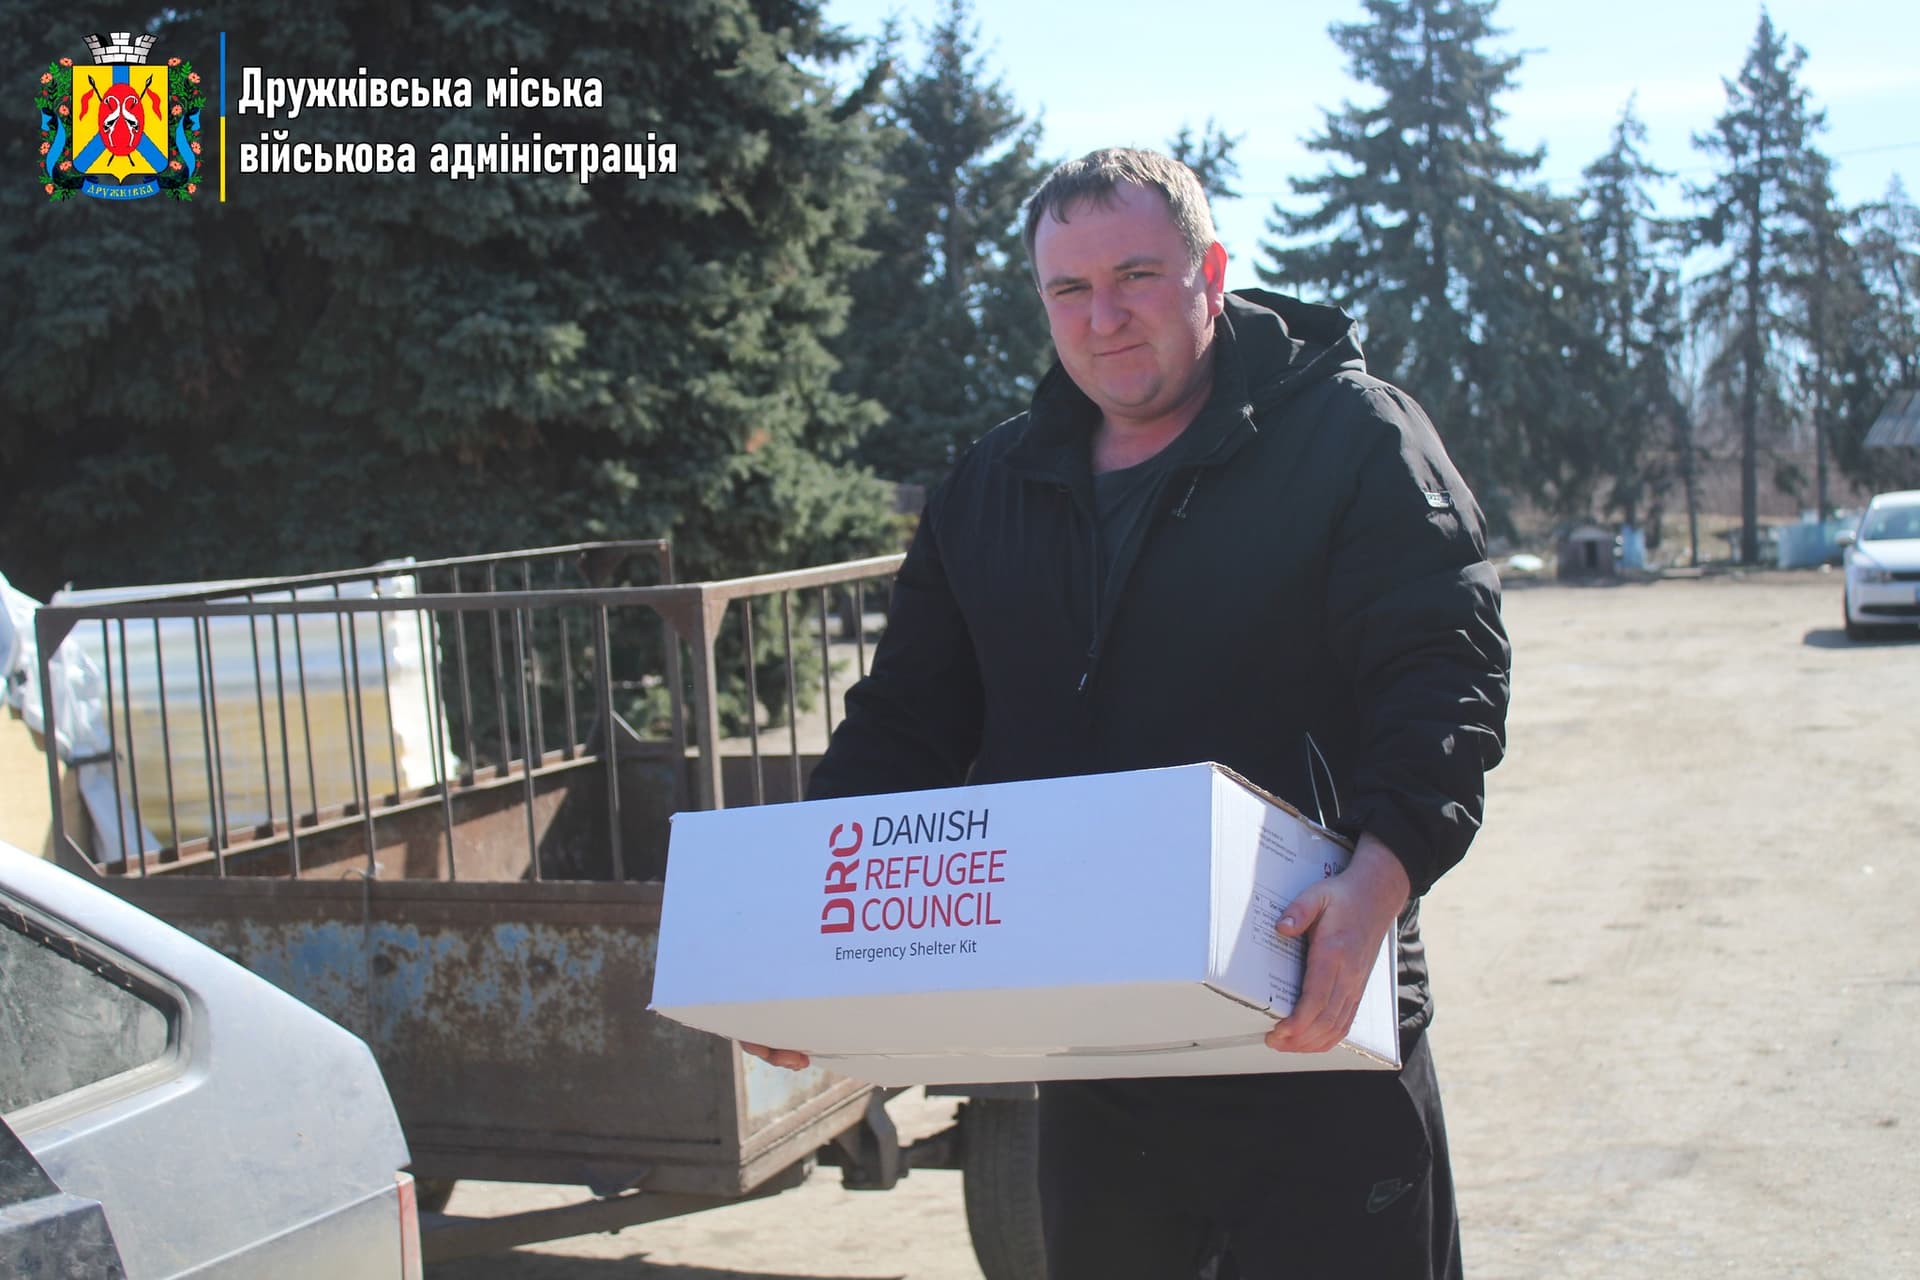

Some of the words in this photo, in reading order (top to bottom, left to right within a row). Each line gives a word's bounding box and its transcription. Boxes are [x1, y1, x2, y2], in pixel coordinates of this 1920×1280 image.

[872, 808, 989, 847] DANISH
[820, 821, 864, 934] DRC
[864, 849, 1008, 891] REFUGEE
[861, 891, 1001, 932] COUNCIL
[835, 944, 906, 963] Emergency
[909, 940, 956, 957] Shelter
[959, 939, 977, 954] Kit
